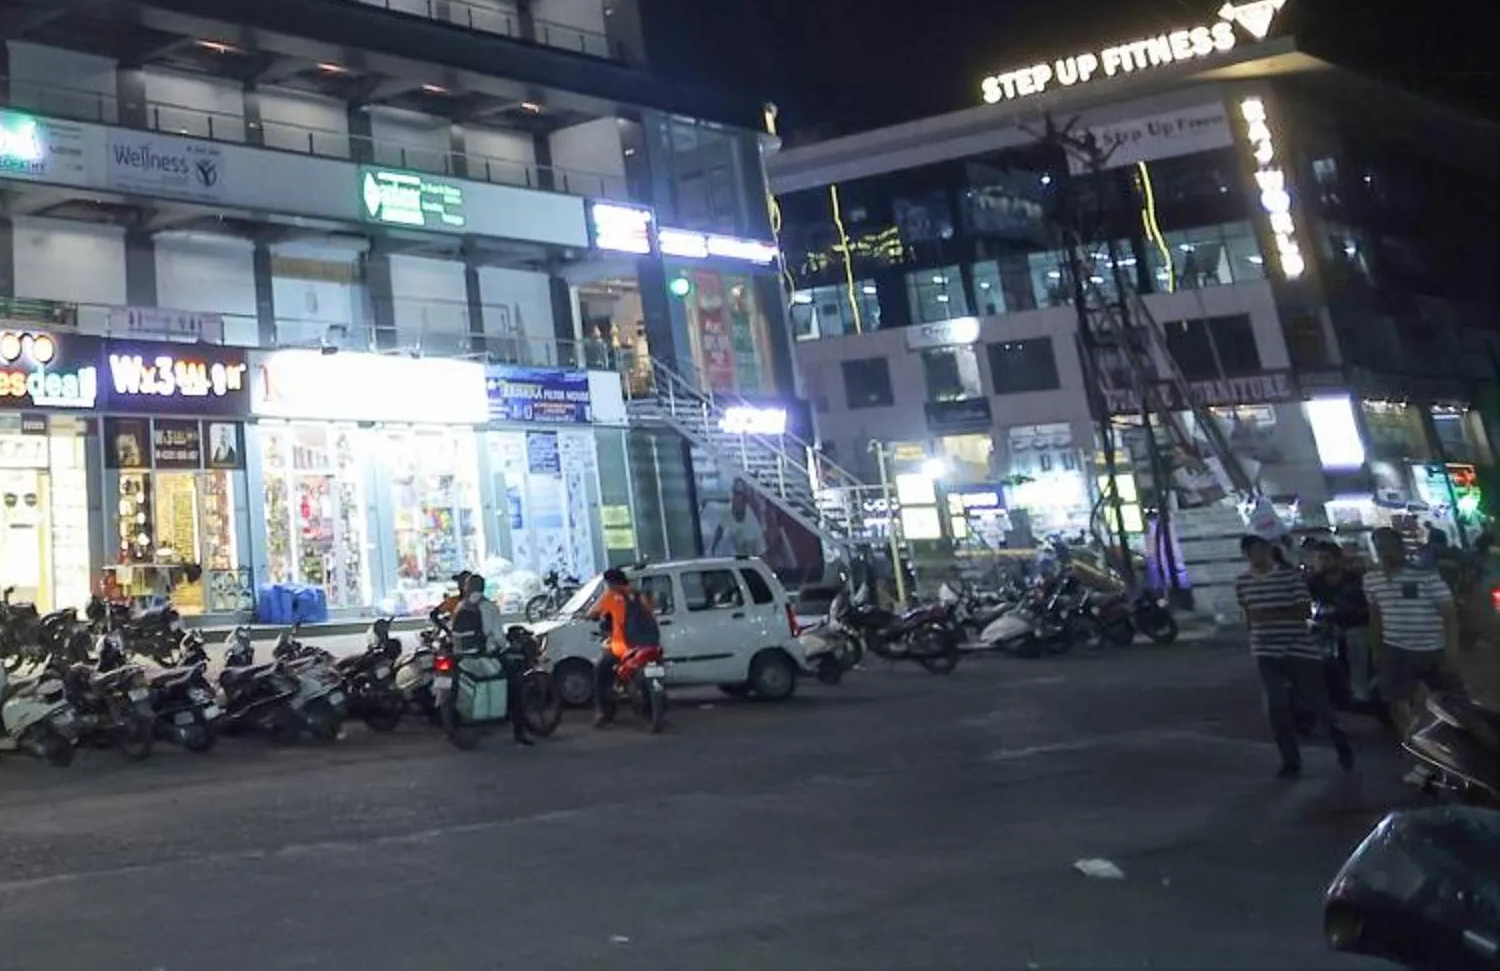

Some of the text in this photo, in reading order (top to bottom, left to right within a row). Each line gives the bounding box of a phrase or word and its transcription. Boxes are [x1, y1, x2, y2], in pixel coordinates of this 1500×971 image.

[981, 21, 1236, 105] STEP UP FITNESS
[113, 144, 189, 174] Wellness
